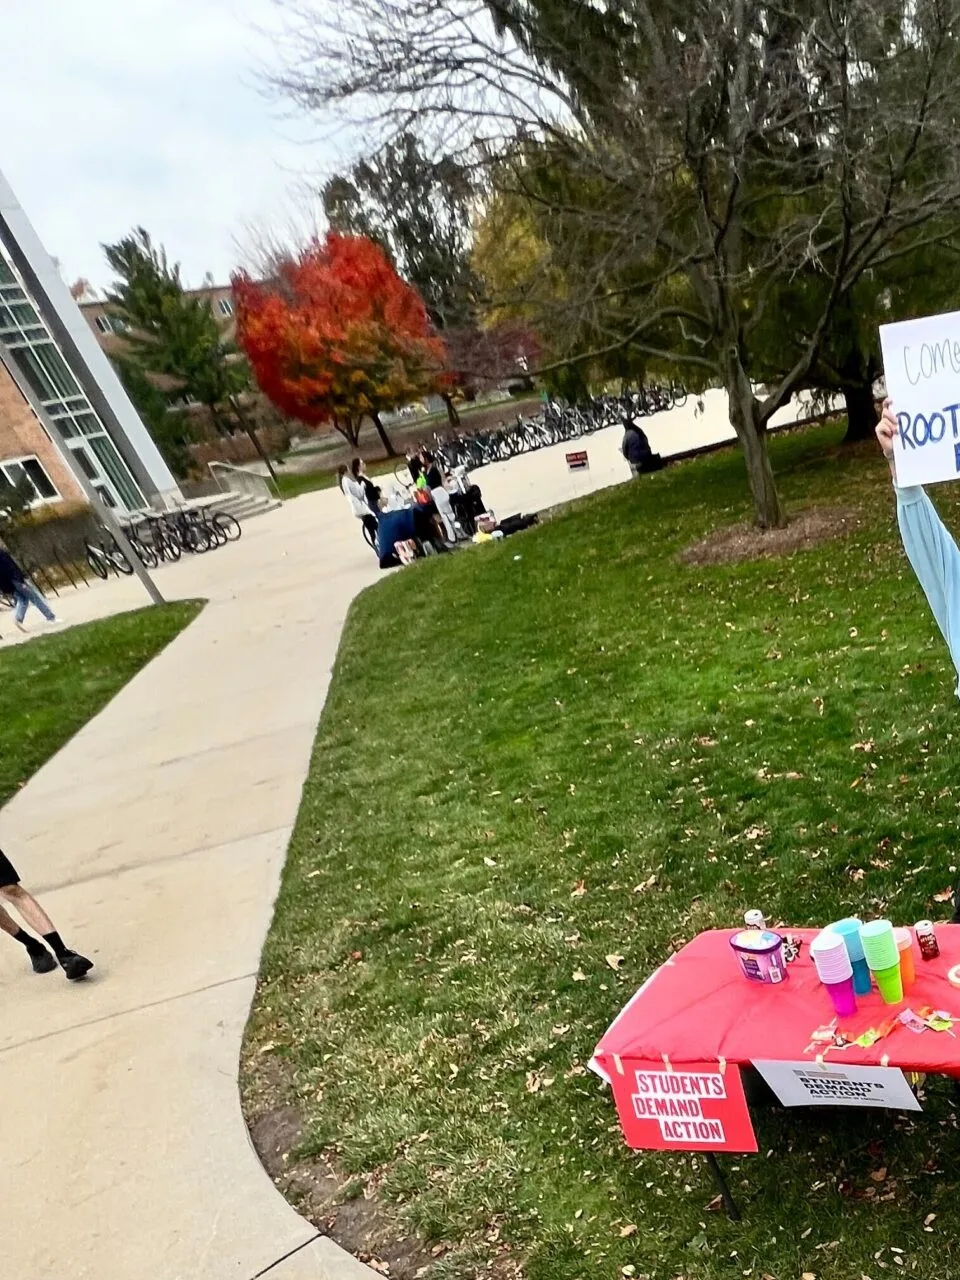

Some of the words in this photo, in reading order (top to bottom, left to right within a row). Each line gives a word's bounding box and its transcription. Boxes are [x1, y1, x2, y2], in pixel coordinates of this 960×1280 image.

[896, 404, 960, 450] ROOT
[638, 1074, 723, 1095] STUDENTS
[799, 1077, 884, 1088] STUDENTS
[803, 1083, 872, 1093] DEMAND
[810, 1089, 867, 1097] ACTION
[634, 1097, 700, 1117] DEMAND
[664, 1121, 722, 1139] ACTION
